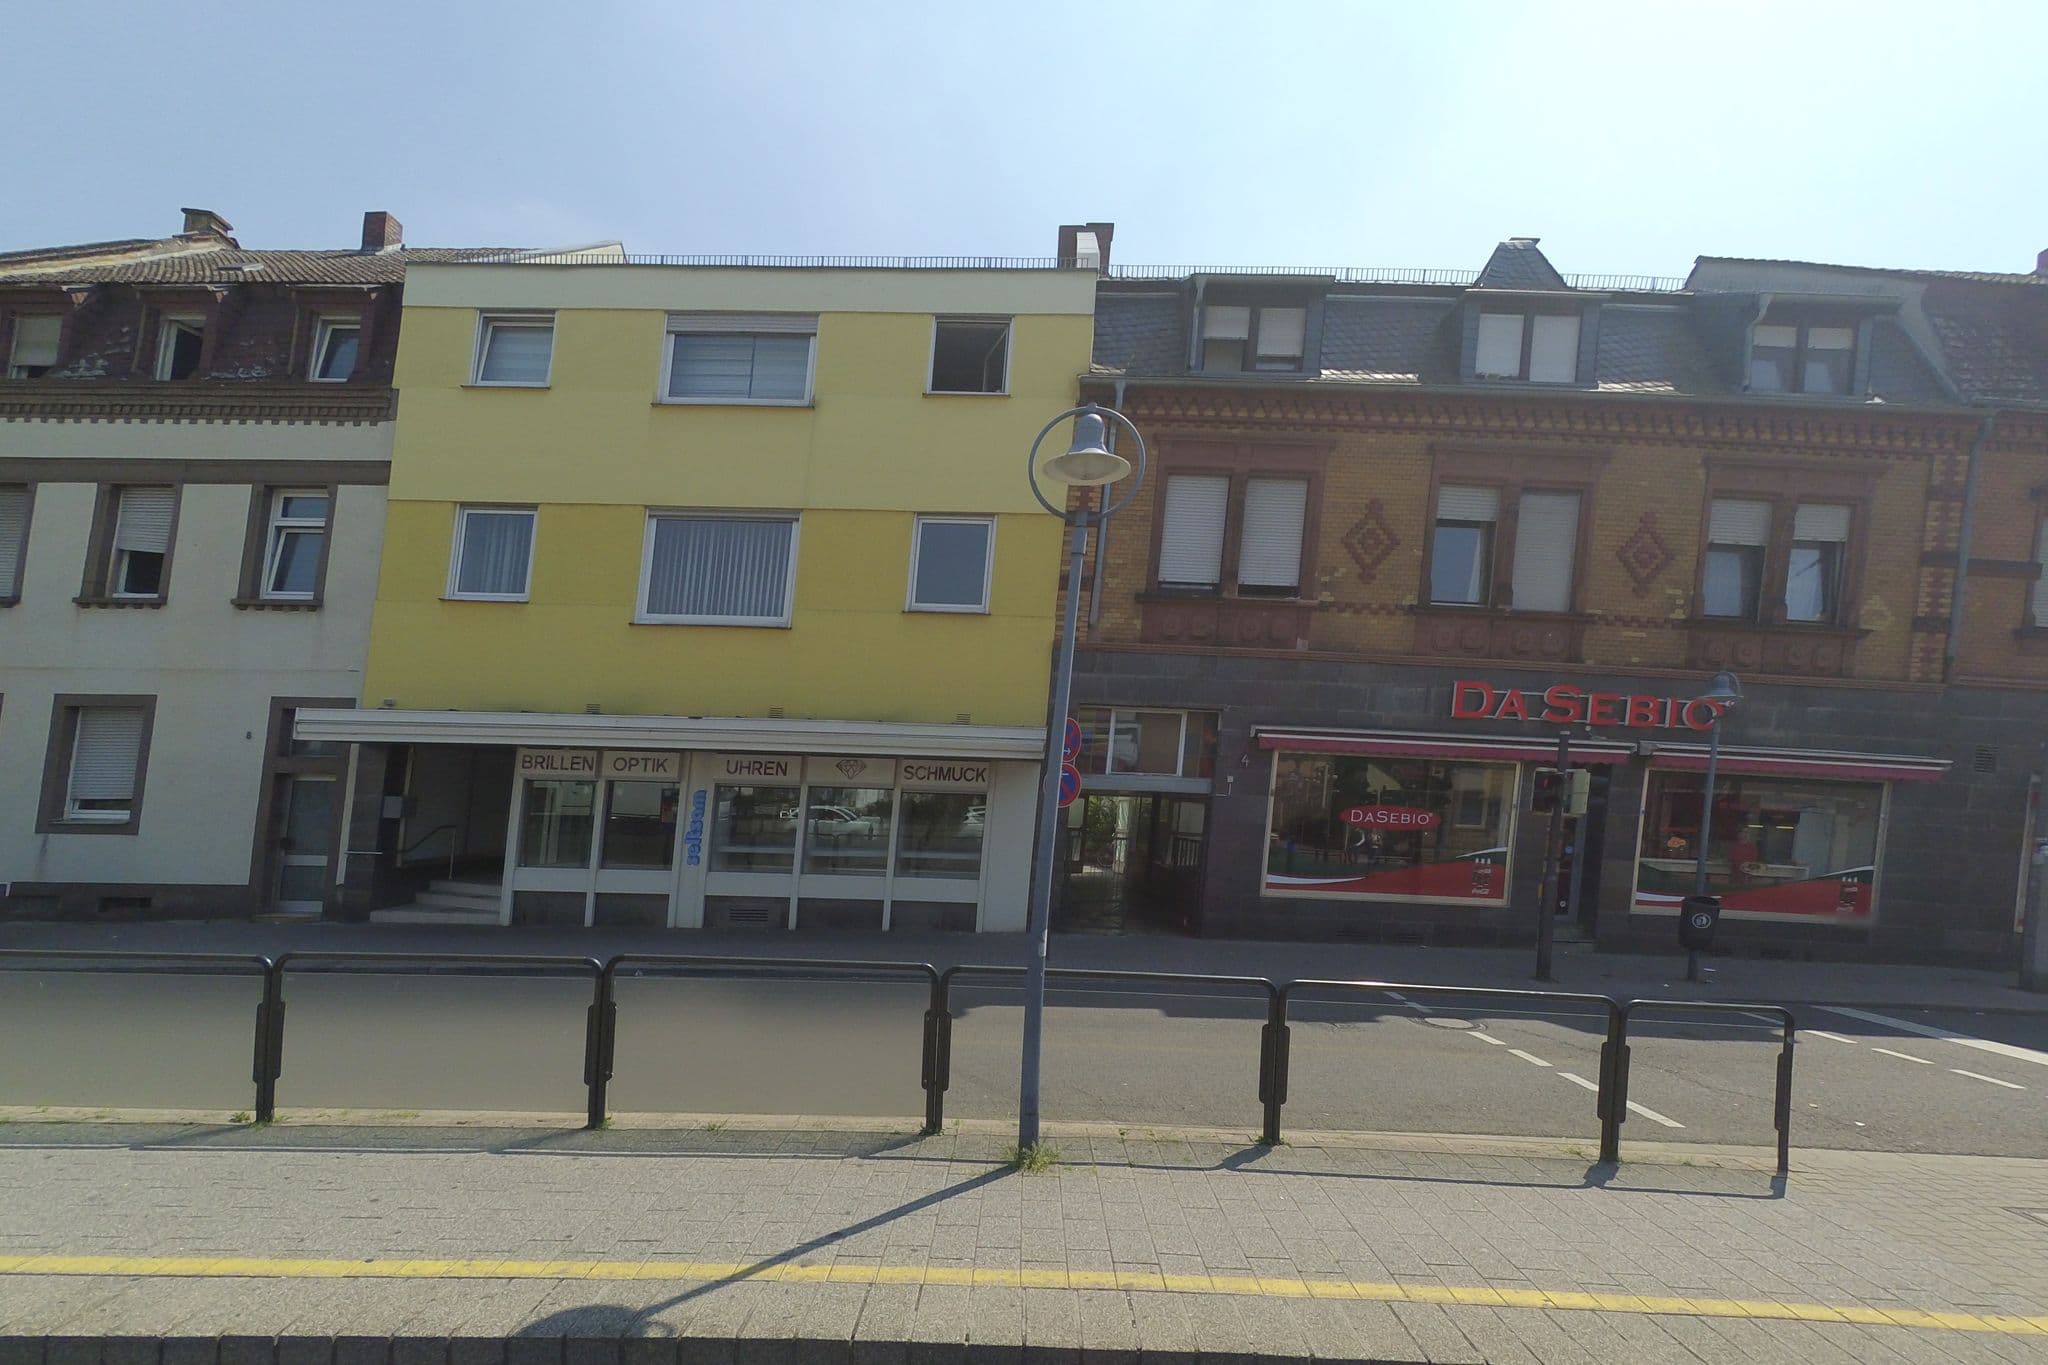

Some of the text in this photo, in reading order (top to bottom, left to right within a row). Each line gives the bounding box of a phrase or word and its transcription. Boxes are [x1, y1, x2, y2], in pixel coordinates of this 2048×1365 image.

[521, 754, 987, 783] BRILLEN OPTIK UHREN SCHMUCK
[1240, 753, 1250, 768] 4
